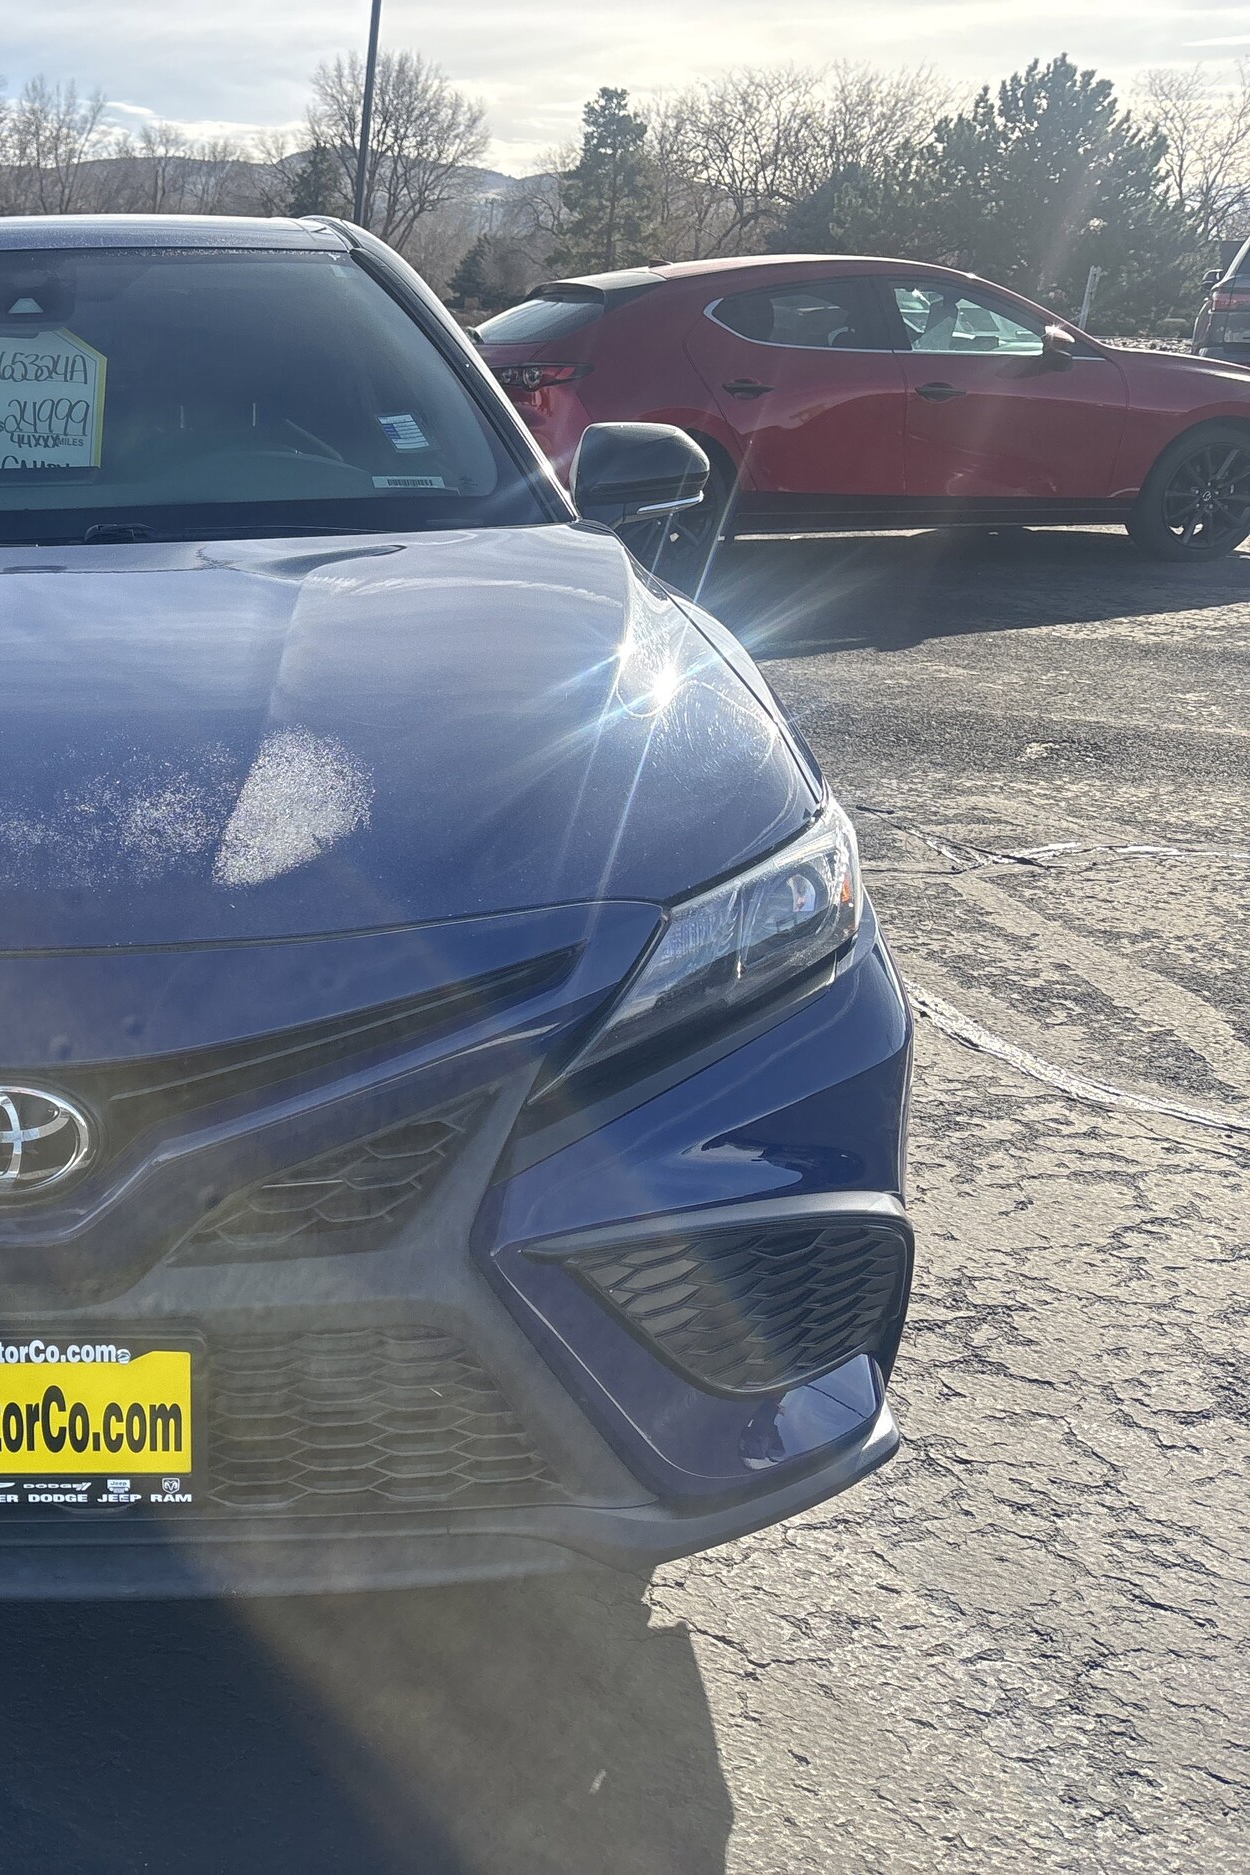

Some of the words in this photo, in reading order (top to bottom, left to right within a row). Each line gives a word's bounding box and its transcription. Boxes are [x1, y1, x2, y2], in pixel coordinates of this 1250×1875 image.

[57, 438, 84, 447] MILES
[28, 1493, 88, 1503] DODGE
[97, 1493, 142, 1503] JEEP
[150, 1493, 192, 1503] RAM
